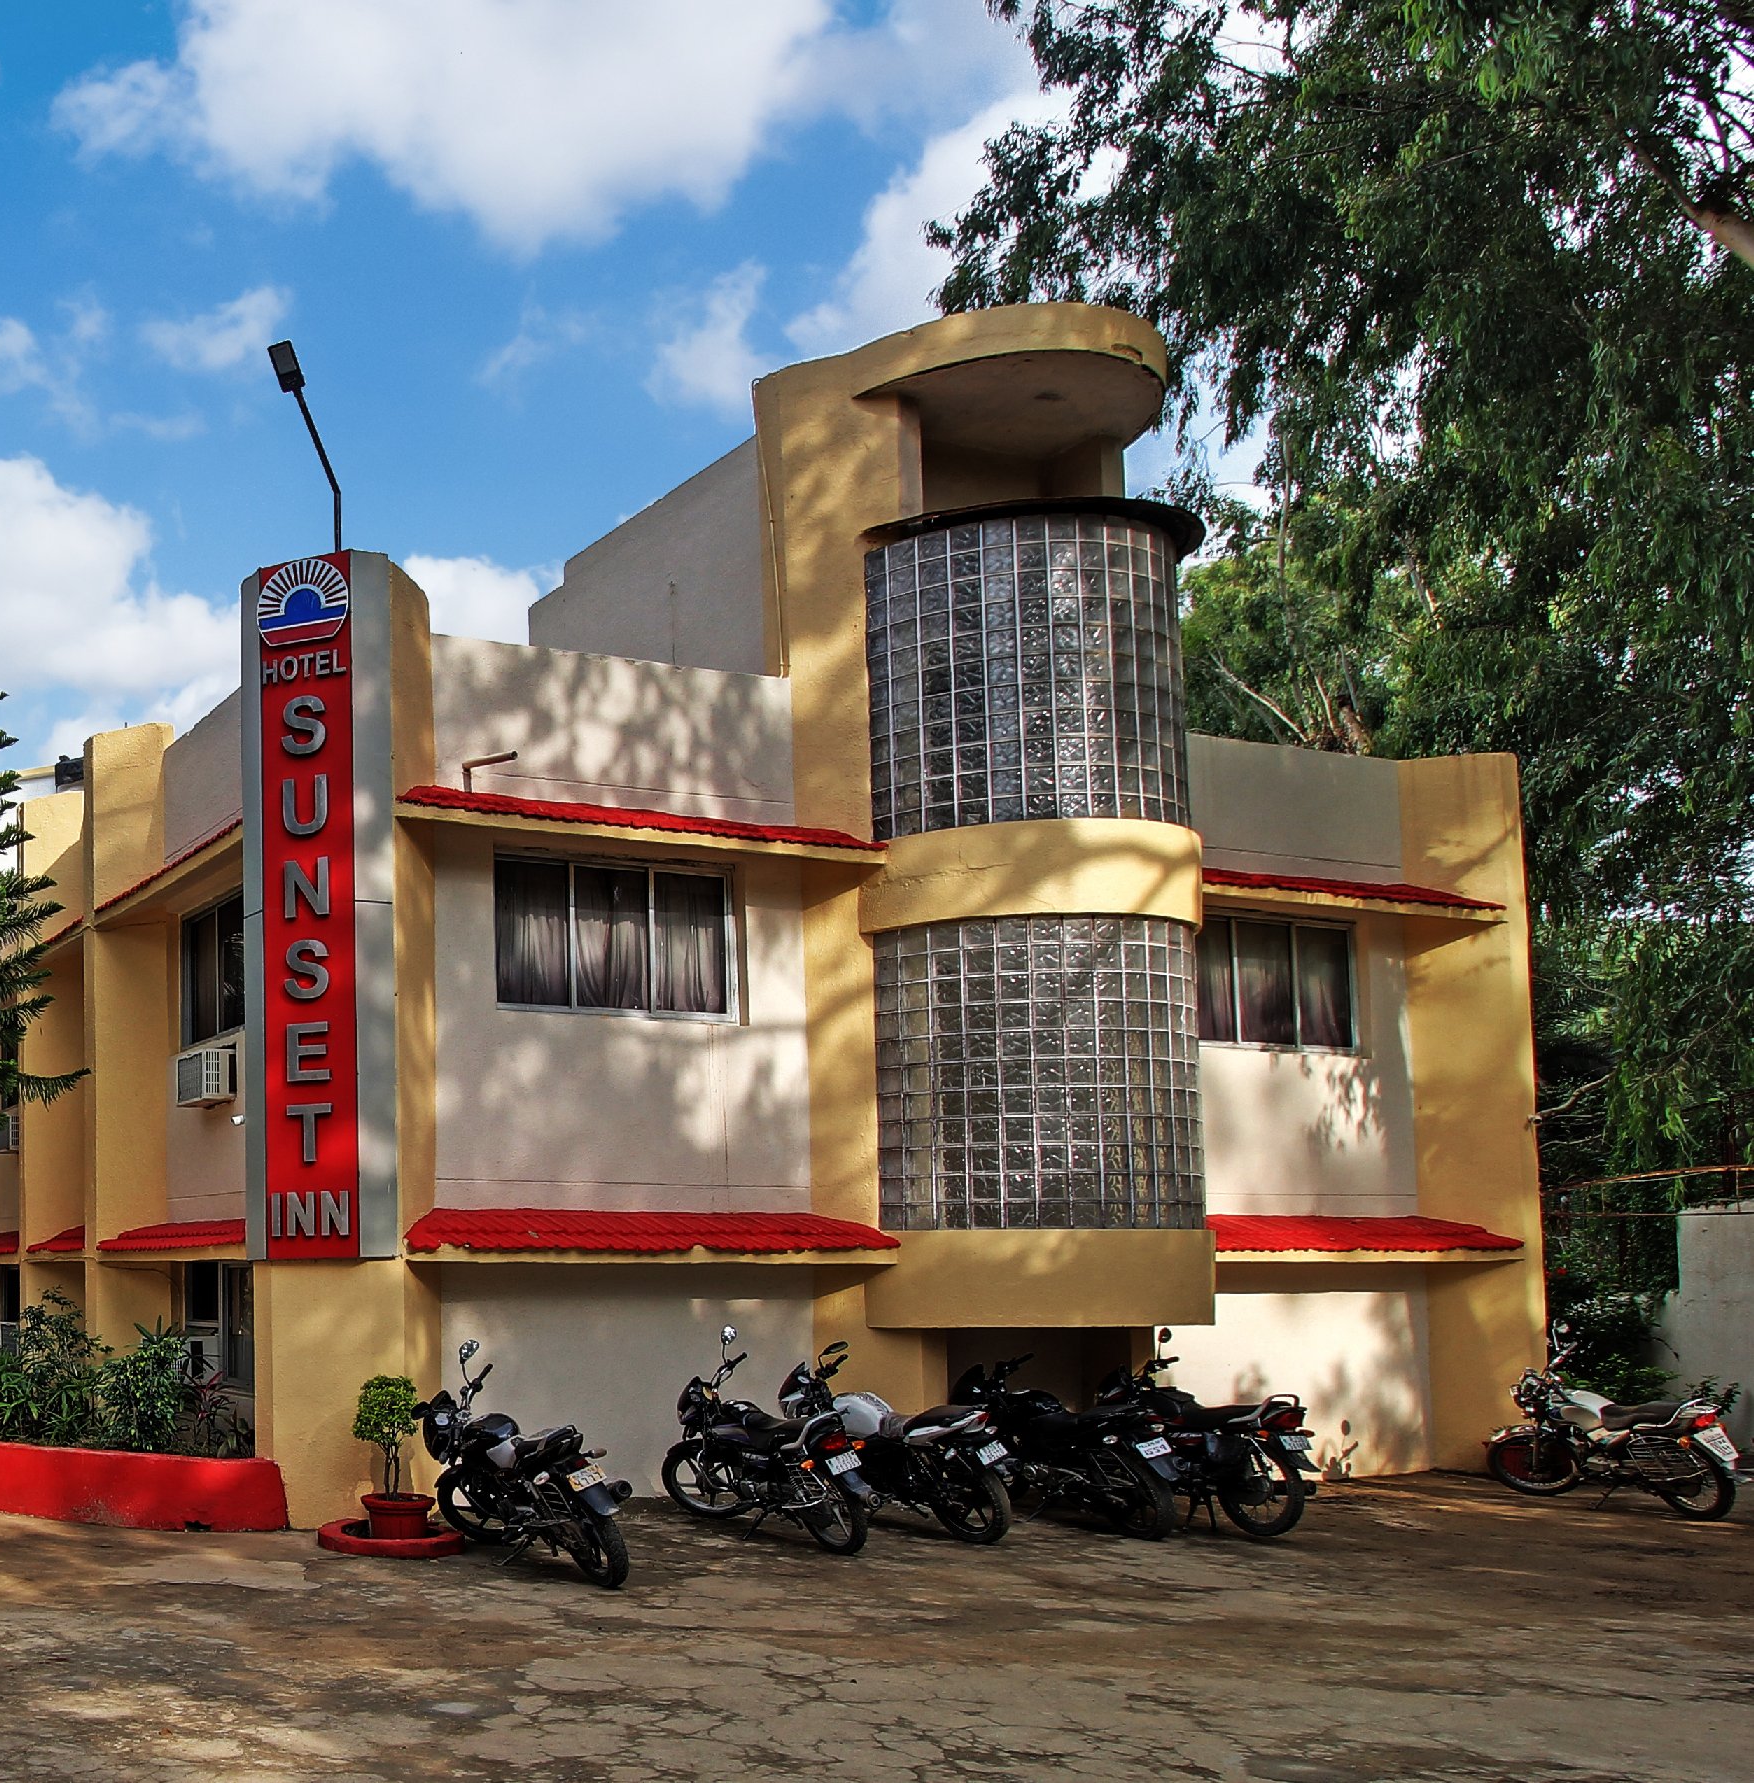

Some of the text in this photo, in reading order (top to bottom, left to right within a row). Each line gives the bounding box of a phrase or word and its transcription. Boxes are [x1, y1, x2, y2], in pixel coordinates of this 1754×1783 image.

[262, 649, 347, 685] HOTEL
[280, 695, 333, 1163] SUNSET
[271, 1190, 350, 1237] INN
